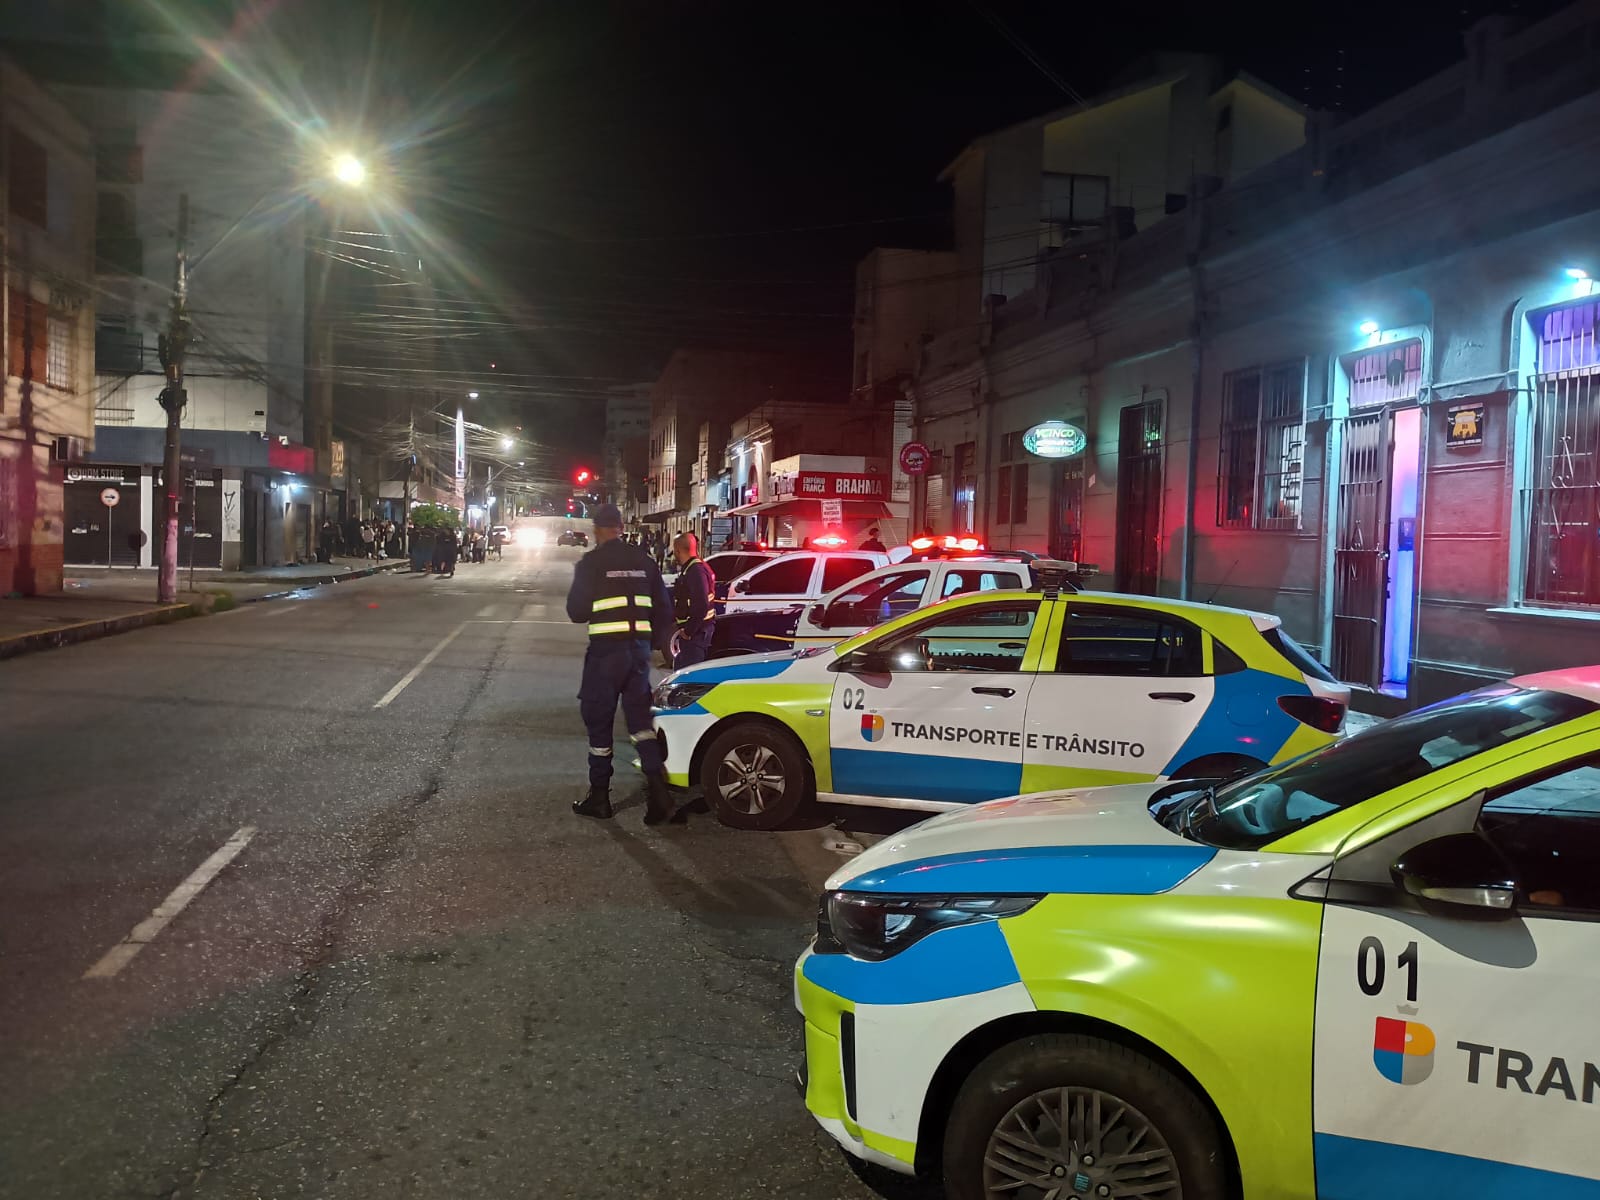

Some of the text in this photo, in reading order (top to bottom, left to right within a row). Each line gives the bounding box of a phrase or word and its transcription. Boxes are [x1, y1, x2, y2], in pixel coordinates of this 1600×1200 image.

[803, 484, 826, 494] FRANÇA
[836, 479, 882, 495] BRAHMA
[843, 688, 865, 710] 02
[892, 722, 1145, 758] TRANSPORTE E TRÂNSITO
[1357, 936, 1418, 1002] 01
